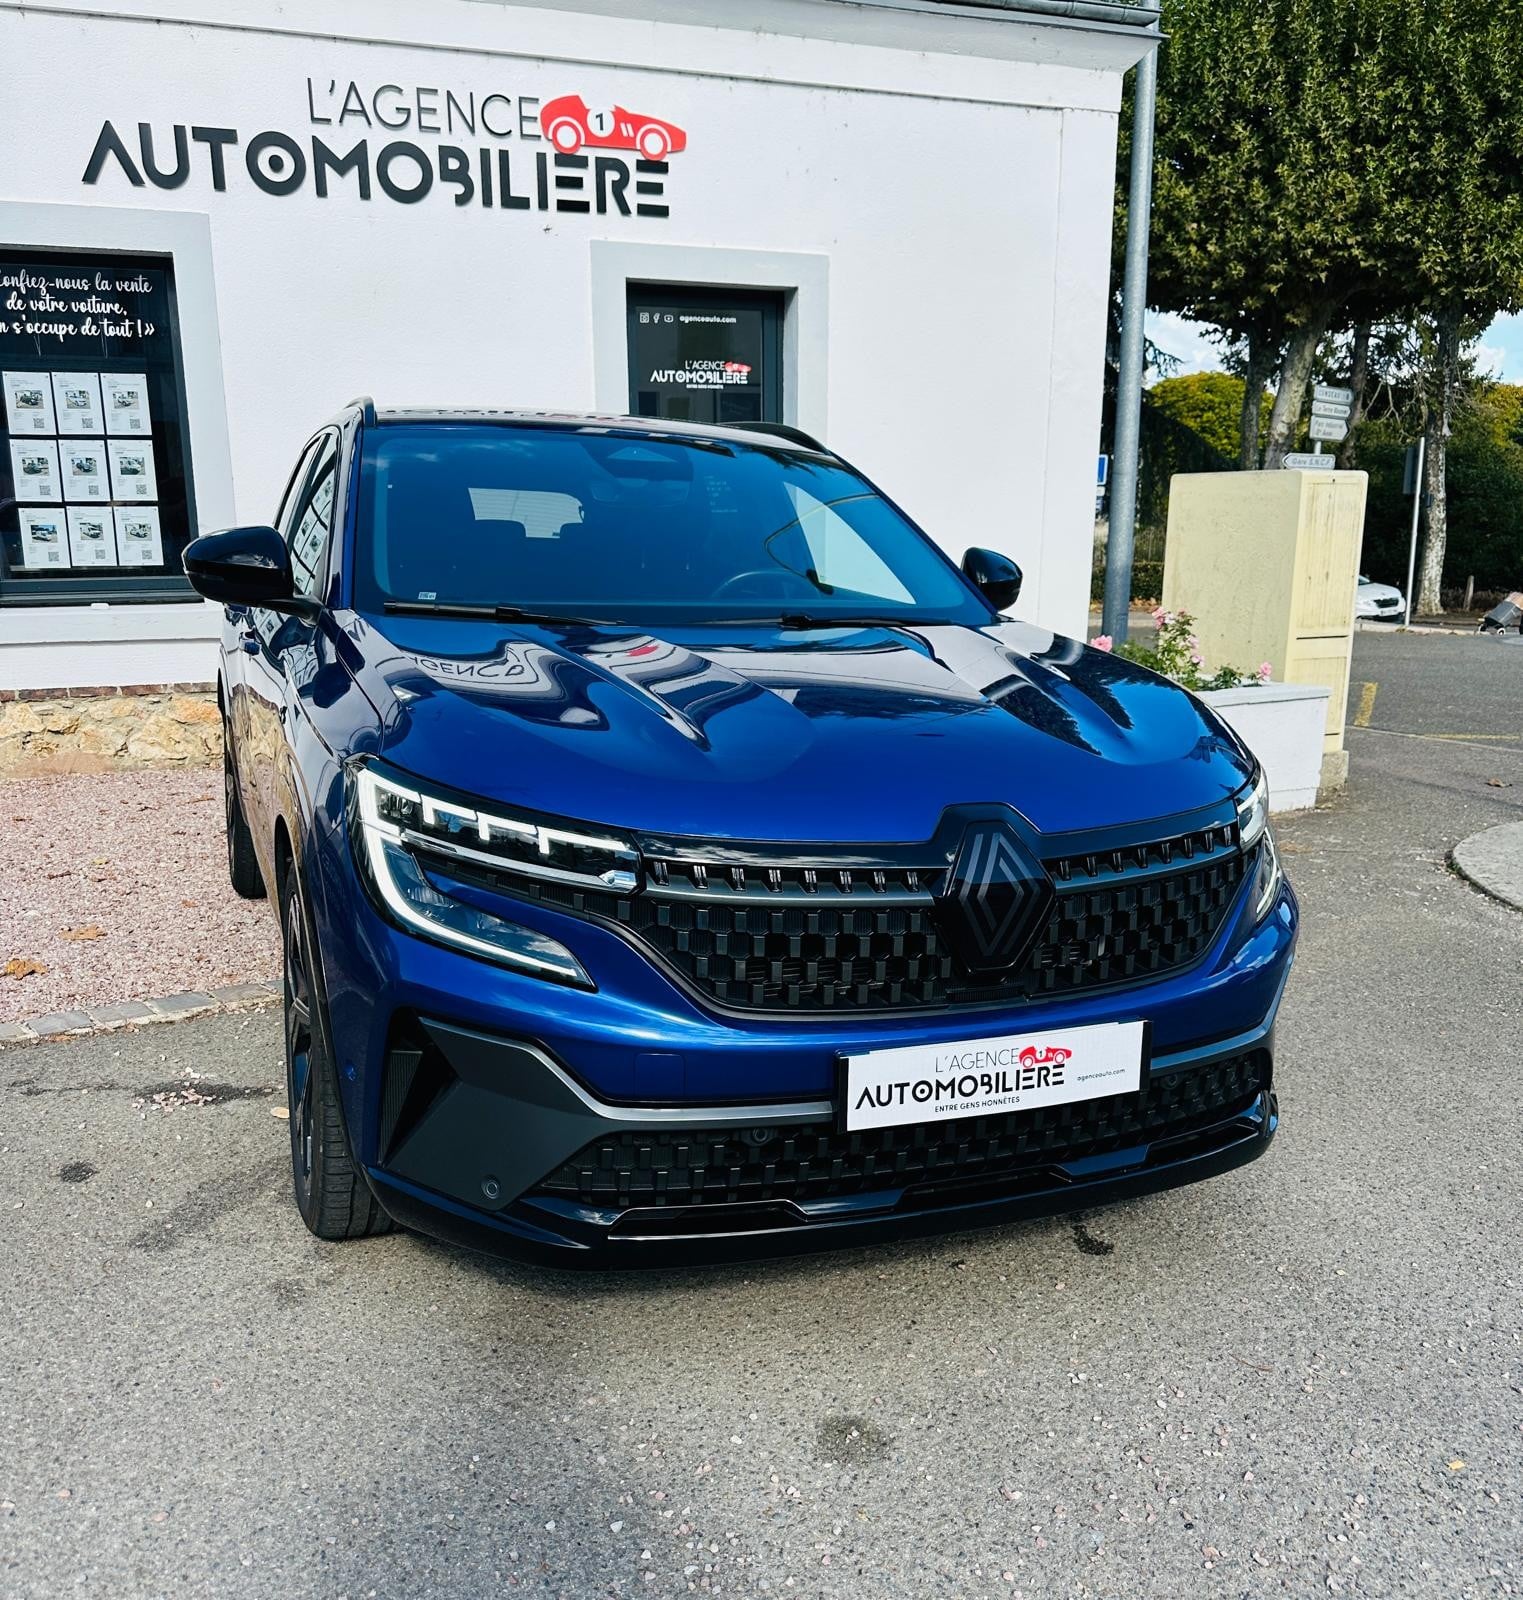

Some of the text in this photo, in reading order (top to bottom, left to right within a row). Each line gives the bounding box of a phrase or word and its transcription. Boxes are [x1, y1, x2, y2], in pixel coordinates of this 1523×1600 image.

[307, 77, 542, 141] L'AGENCE
[95, 272, 113, 291] la
[115, 275, 153, 293] vente
[7, 291, 128, 315] de votre voiture,
[13, 314, 78, 343] s'occupe
[81, 317, 100, 336] de
[100, 318, 135, 338] tout
[679, 314, 737, 324] agenceauto.com
[685, 360, 725, 371] L'AGENCE
[935, 1048, 1020, 1073] L'AGENCE
[1076, 1068, 1126, 1083] agenceauto.com
[934, 1103, 959, 1113] ENTRE
[959, 1101, 980, 1110] GENS
